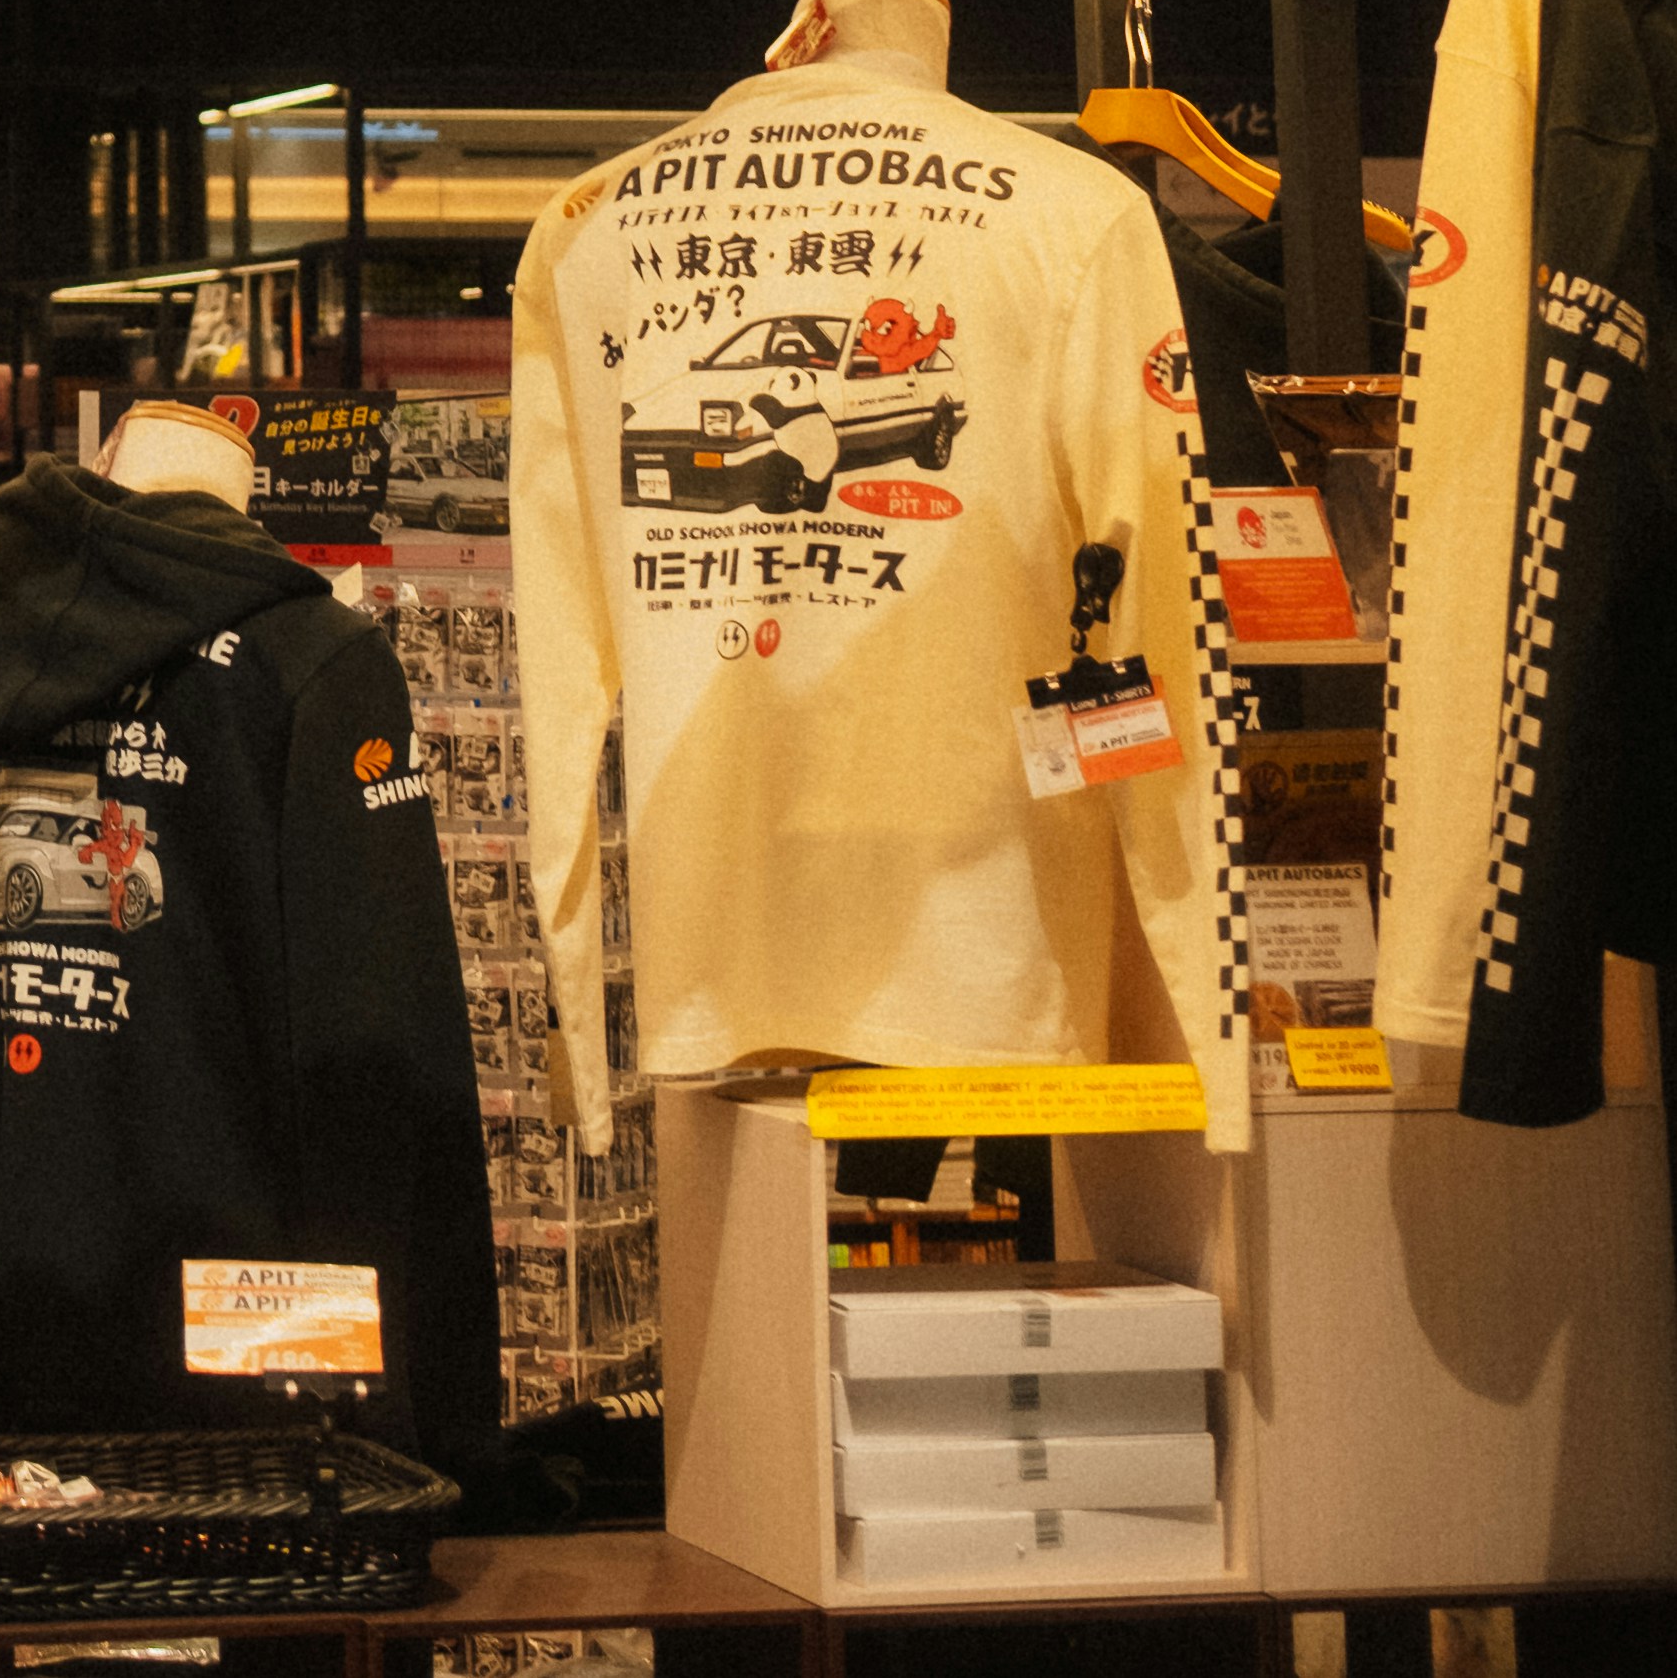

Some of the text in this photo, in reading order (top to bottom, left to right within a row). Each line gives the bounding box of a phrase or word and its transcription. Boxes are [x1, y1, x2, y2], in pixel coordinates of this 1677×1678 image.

[748, 120, 927, 145] SHINONOME
[734, 148, 1017, 203] AUTOBACS
[888, 498, 921, 516] PIT
[646, 527, 674, 541] OLD
[738, 521, 799, 540] SHOWA
[802, 519, 884, 541] MODERN
[1283, 866, 1363, 881] AUTOBACS
